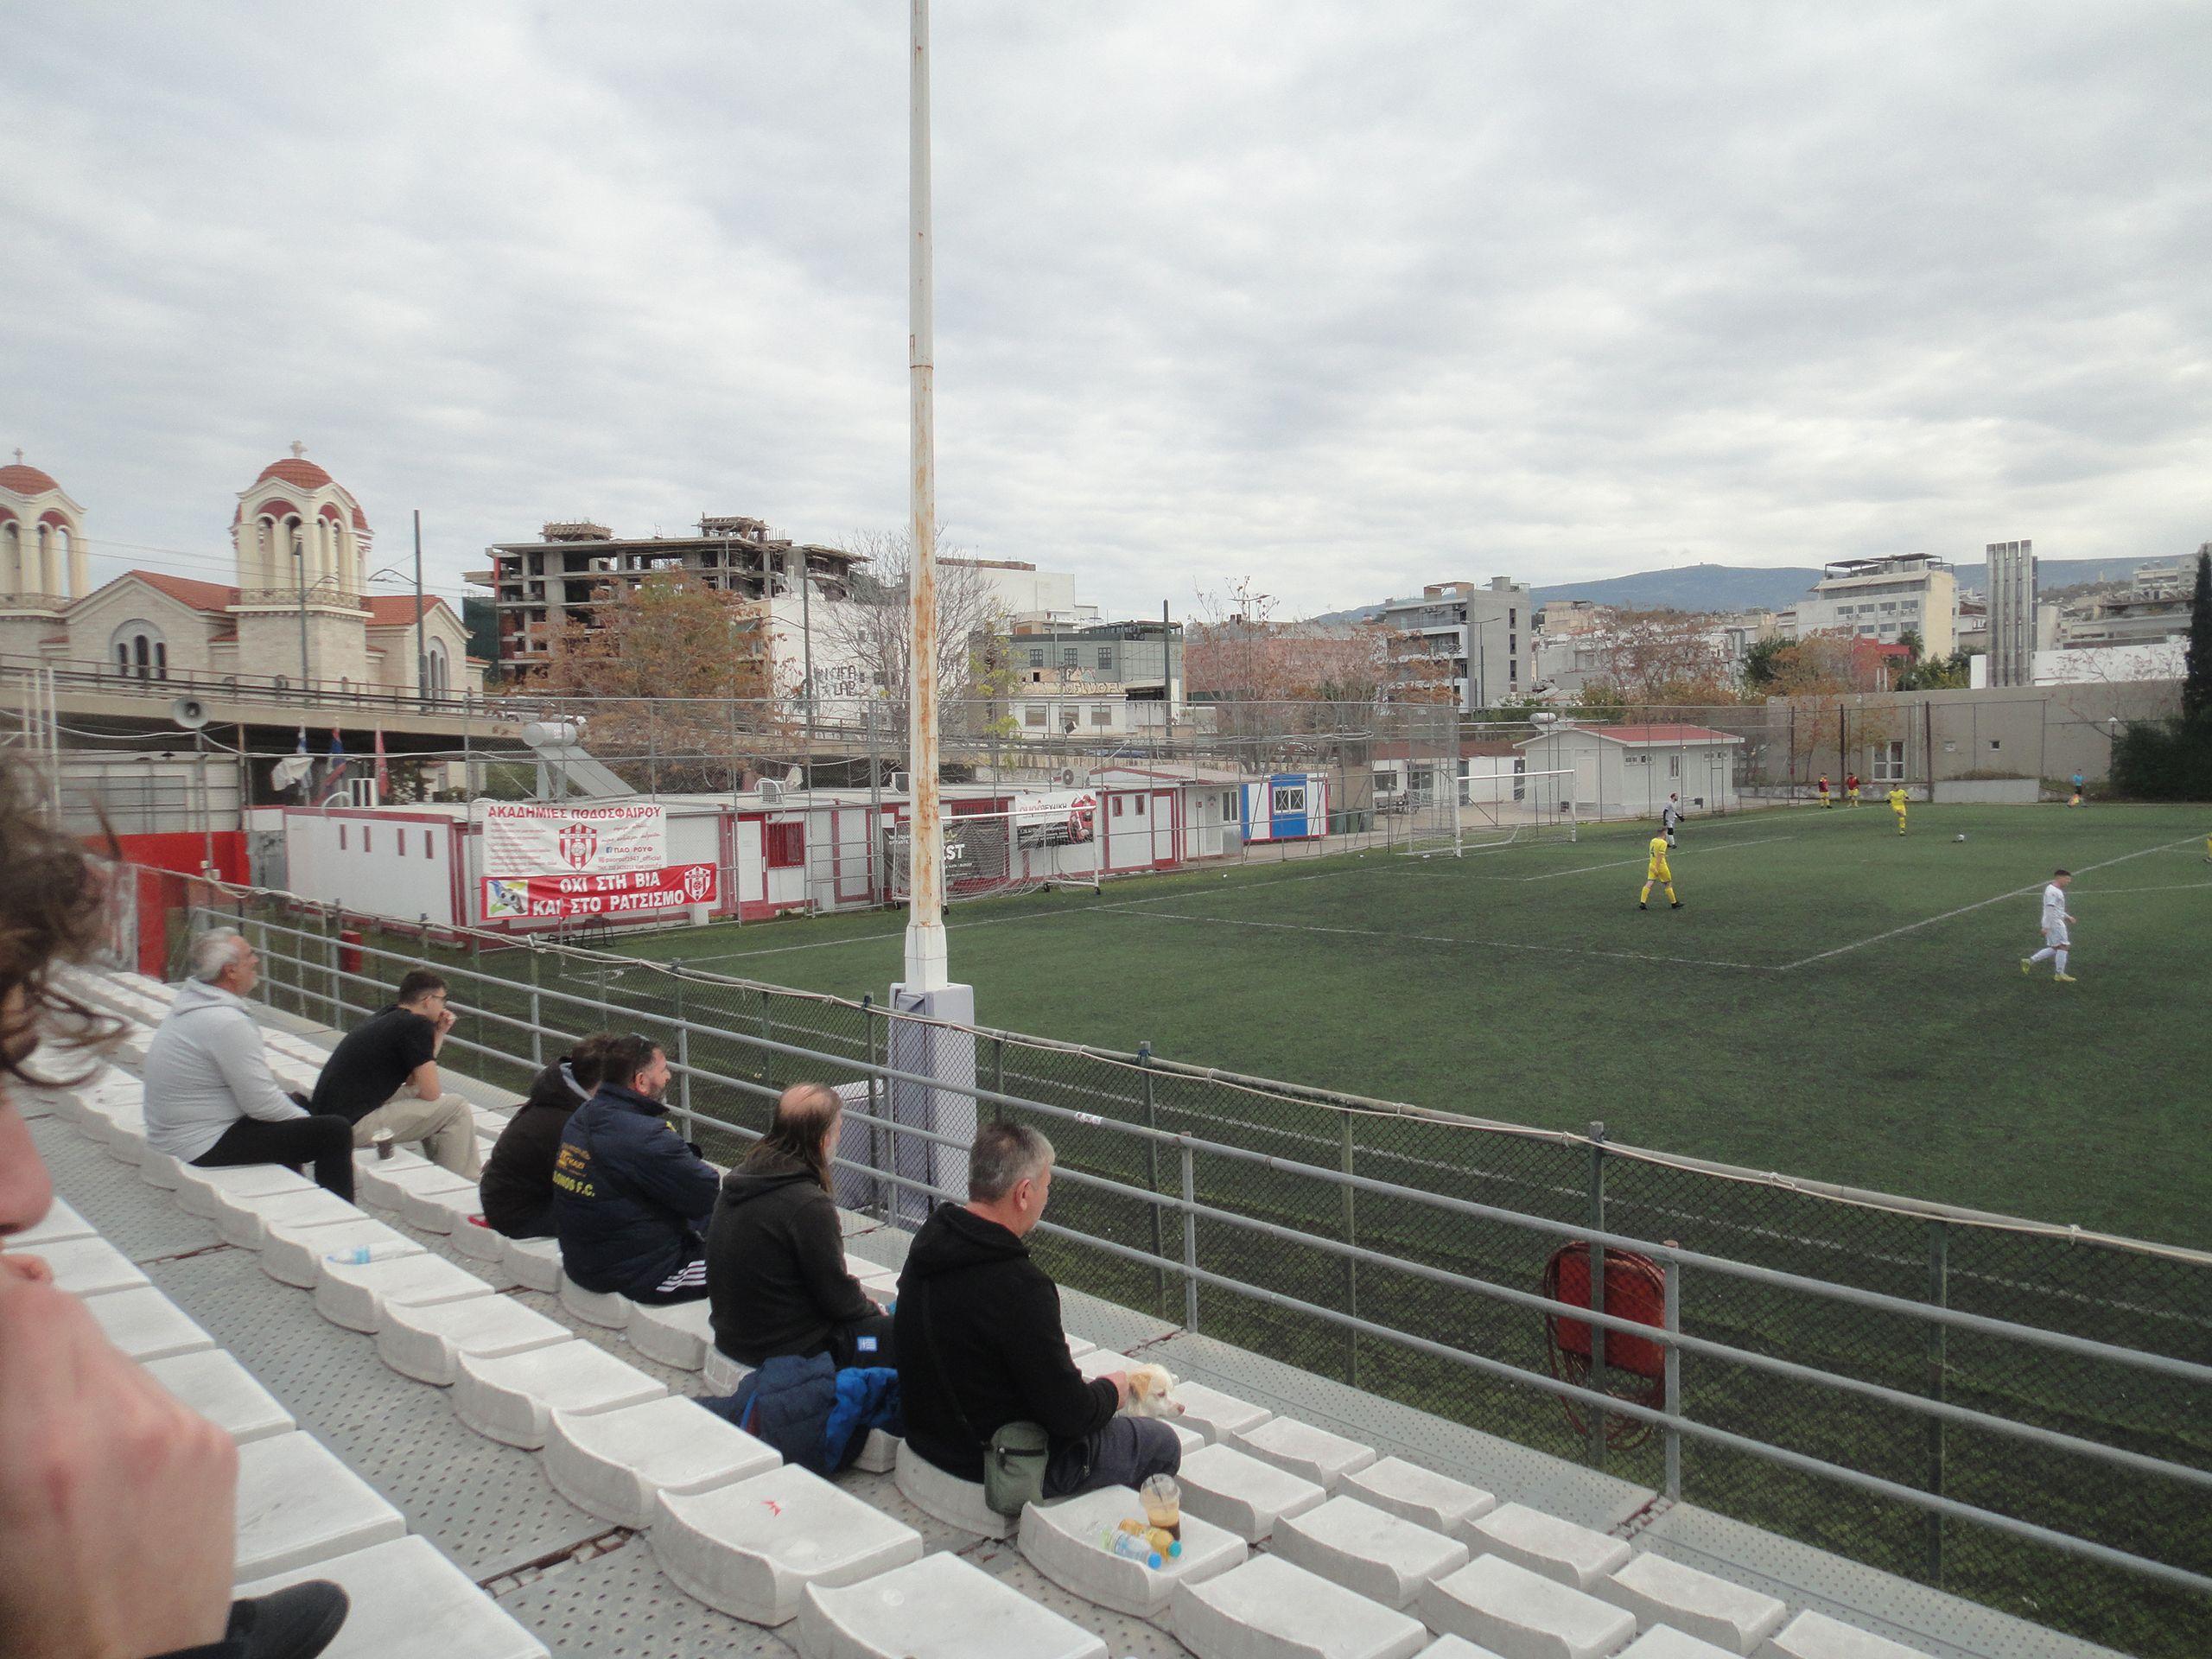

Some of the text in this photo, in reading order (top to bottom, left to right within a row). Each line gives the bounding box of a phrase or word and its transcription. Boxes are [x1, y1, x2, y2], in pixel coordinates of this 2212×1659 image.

[488, 805, 661, 819] ΑΚΑΔΗΜΙΕΣ ΠΟΔΟΣΦΑΙΡΟΥ
[560, 872, 660, 893] ΟΧΙ ΣΤΗ ΒΙΑ
[570, 897, 601, 913] ΣΤΟ
[610, 889, 685, 911] ΡΑΤΣΙΣΜΟ
